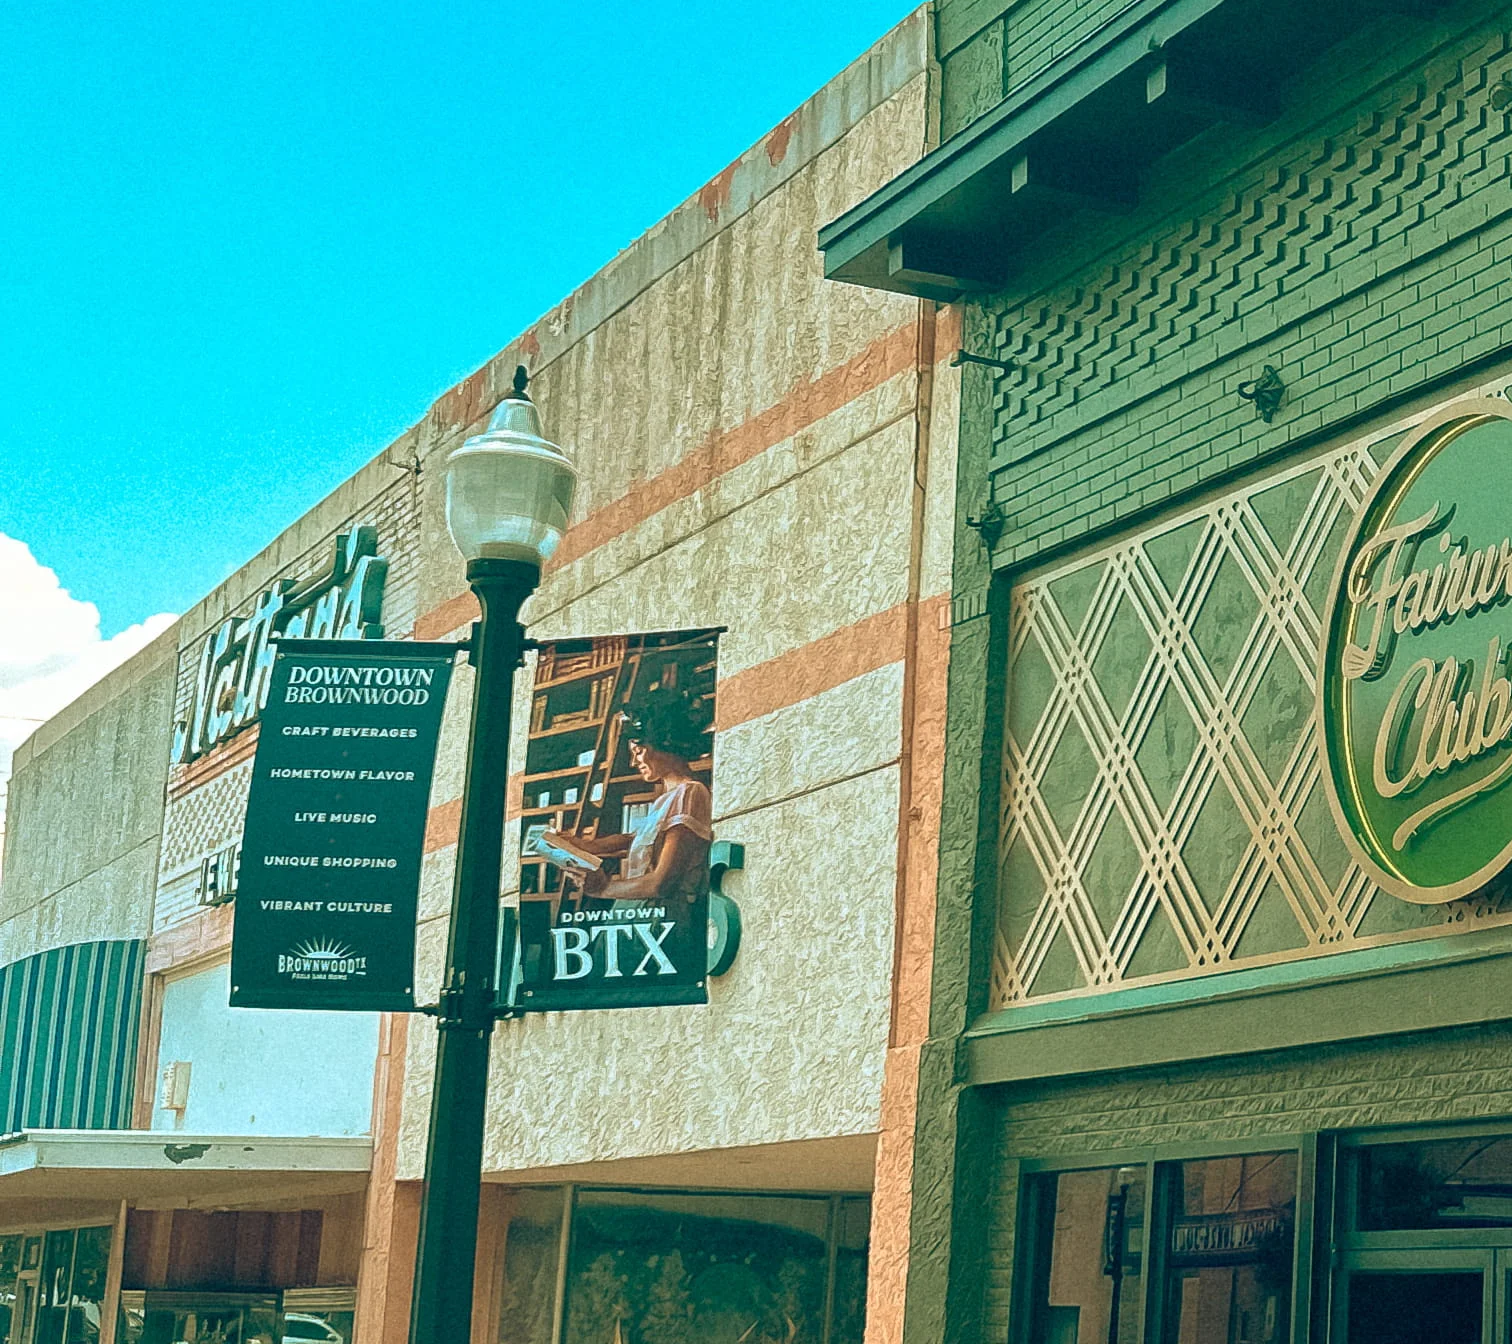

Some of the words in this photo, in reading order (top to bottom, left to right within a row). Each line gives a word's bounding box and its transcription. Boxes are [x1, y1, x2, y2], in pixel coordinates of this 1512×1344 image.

[288, 666, 435, 686] DOWNTOWN
[284, 686, 430, 706] BROWNWOOD
[282, 726, 329, 737] CRAFT
[332, 727, 418, 738] BEVERAGES
[270, 768, 356, 780] HOMETOWN
[358, 769, 416, 781] FLAVOR
[294, 812, 326, 823] LIVE
[330, 813, 377, 824] MUSIC
[264, 855, 319, 867] UNIQUE
[322, 857, 398, 869] SHOPPING
[260, 900, 323, 911] VIBRANT
[326, 902, 393, 913] CULTURE
[561, 906, 667, 924] DOWNTOWN
[550, 922, 678, 981] BTX
[278, 954, 355, 974] BROWNWOOD
